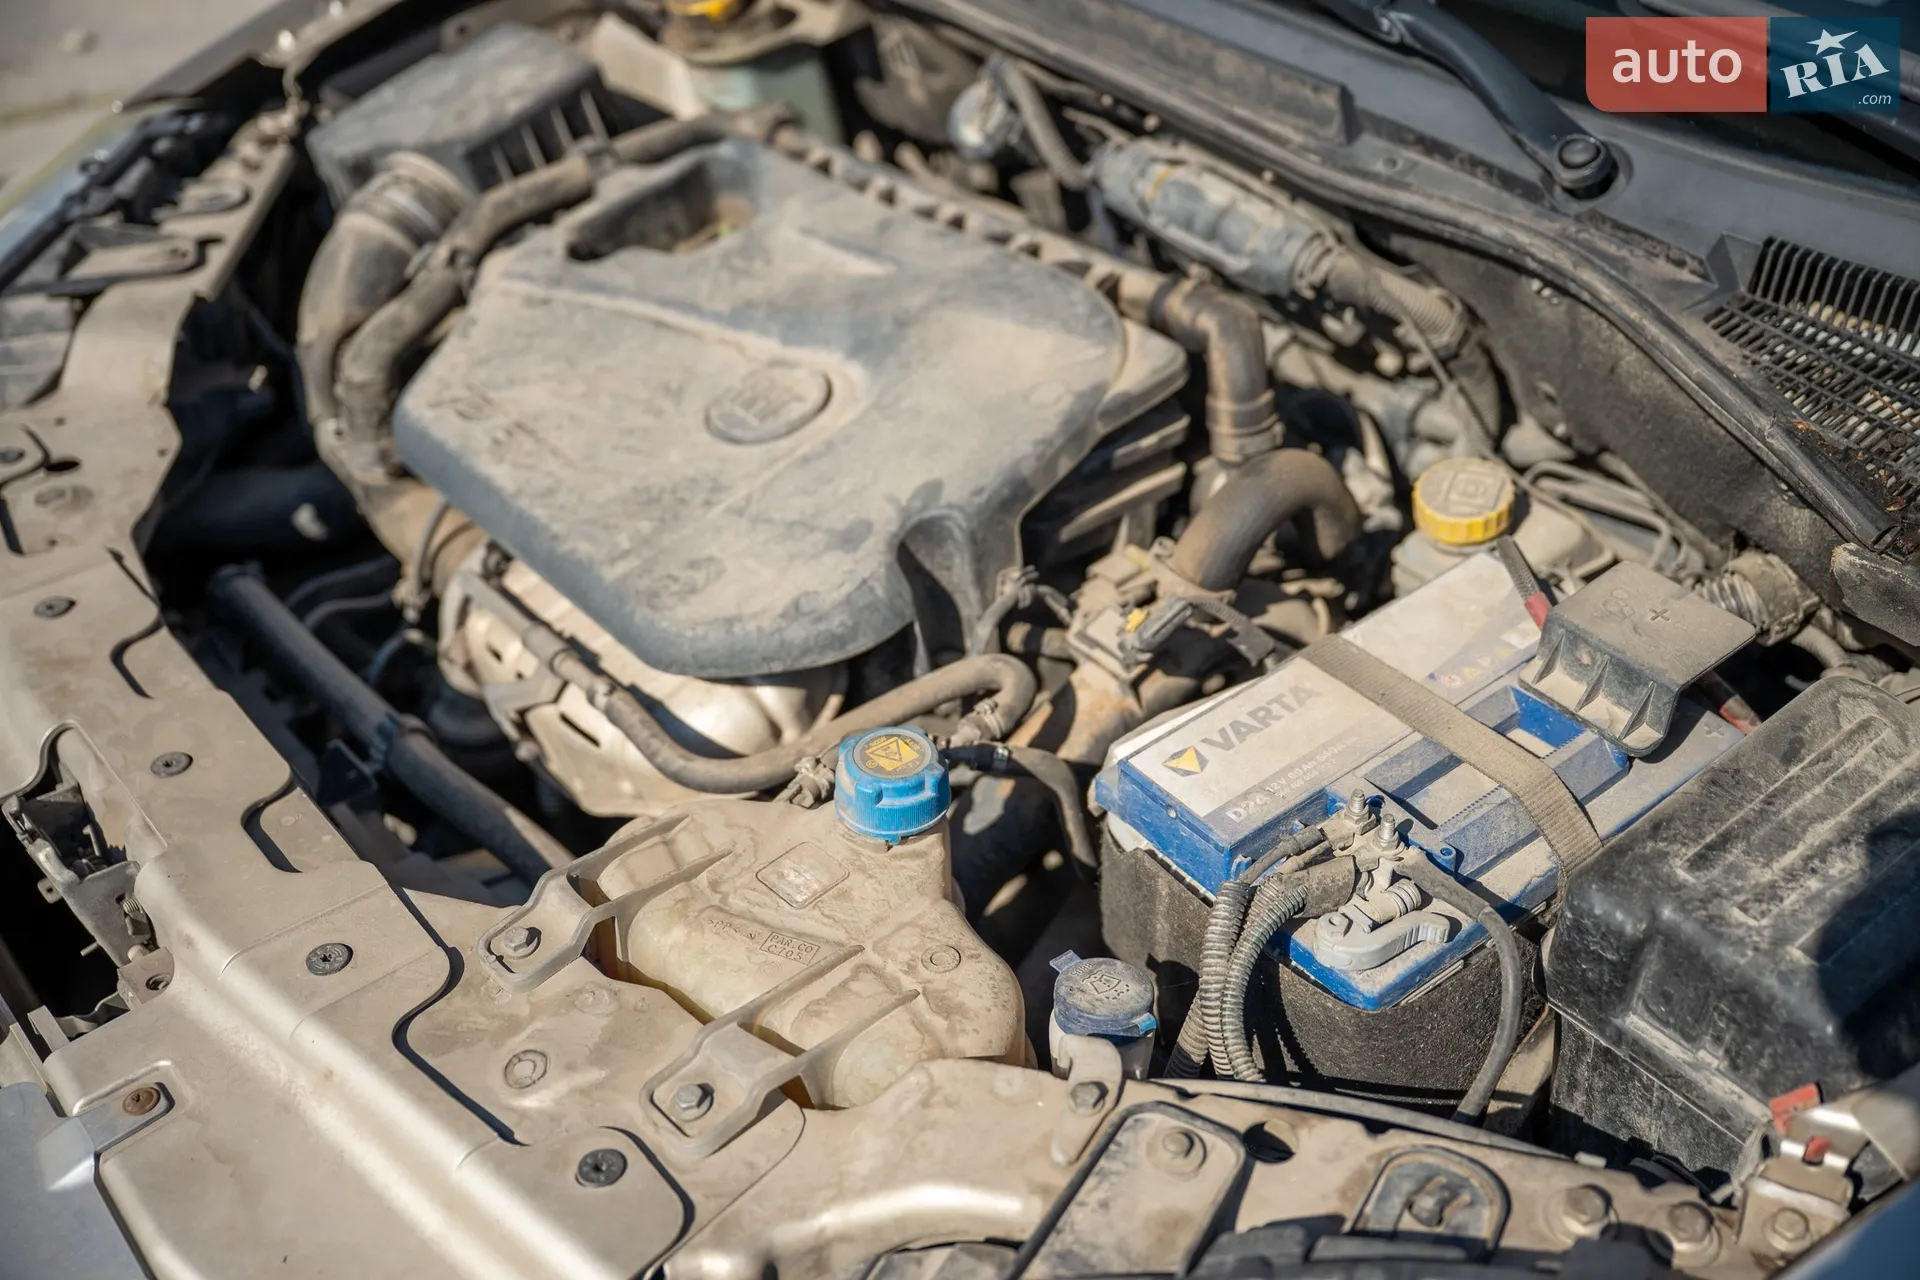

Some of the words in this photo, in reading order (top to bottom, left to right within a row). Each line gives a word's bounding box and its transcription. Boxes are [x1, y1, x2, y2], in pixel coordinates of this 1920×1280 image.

[1200, 686, 1322, 751] VARTA
[767, 944, 804, 961] C705
[770, 934, 814, 954] PAR.CO
